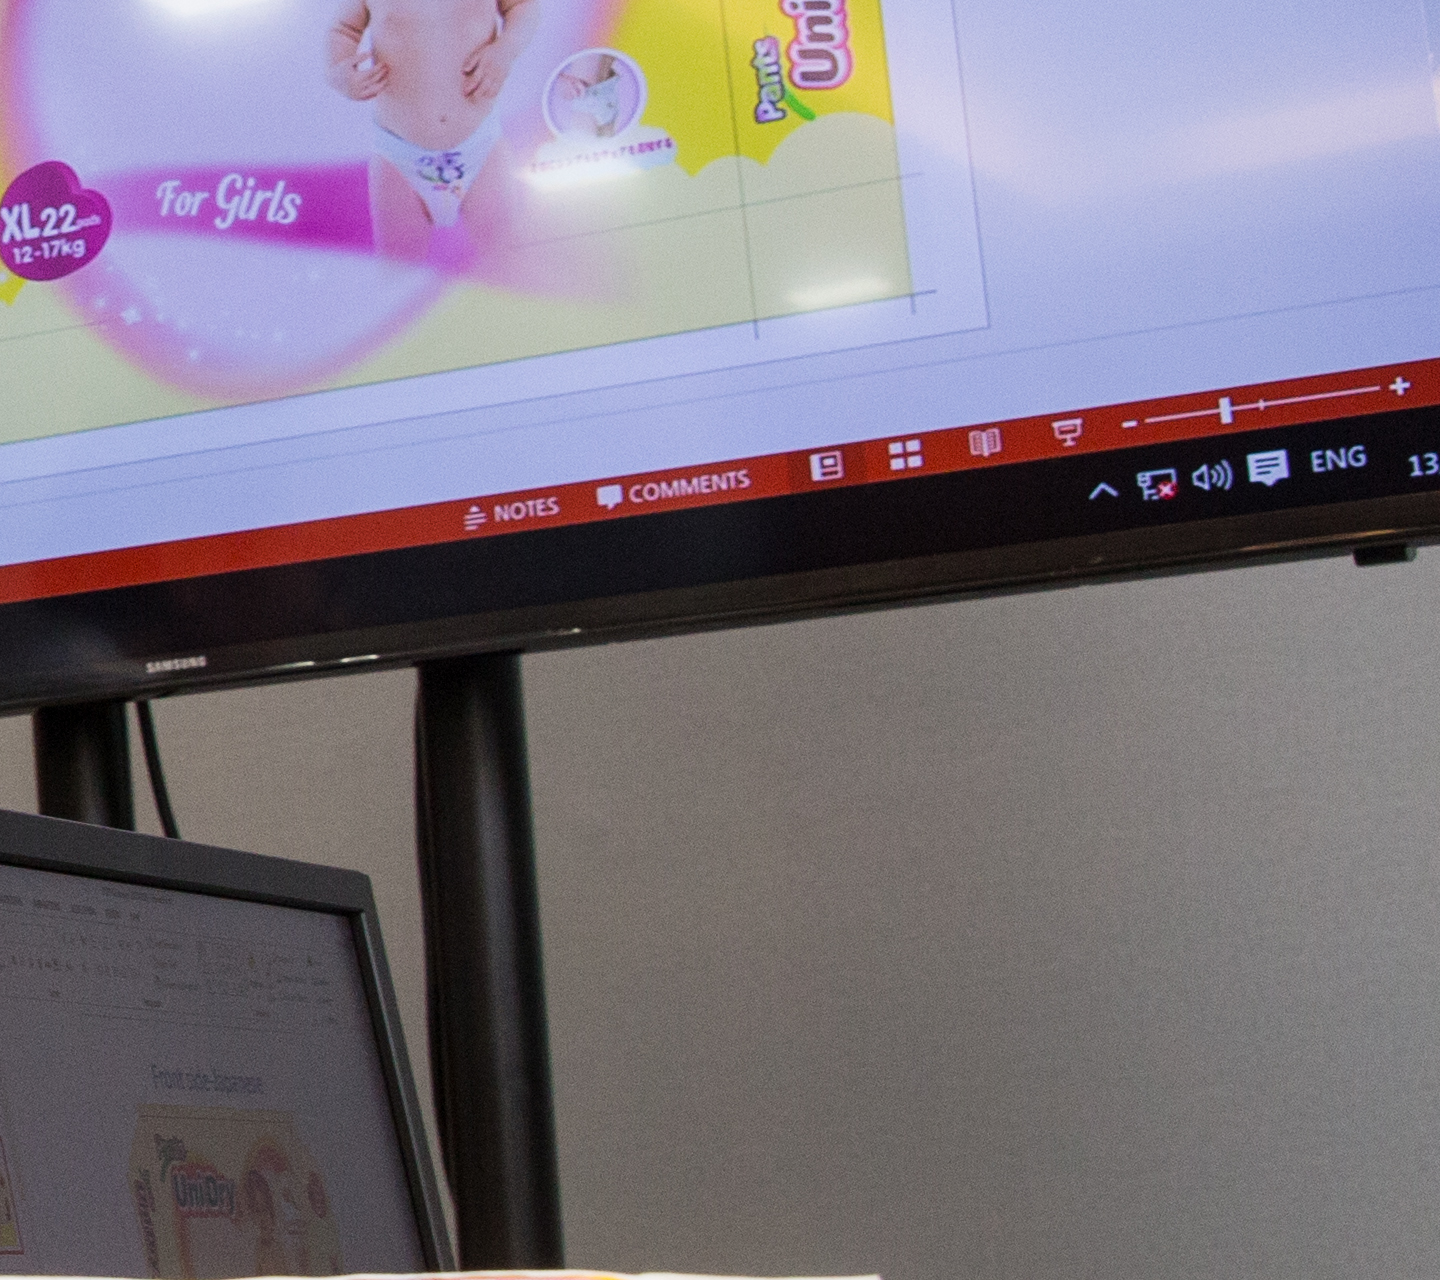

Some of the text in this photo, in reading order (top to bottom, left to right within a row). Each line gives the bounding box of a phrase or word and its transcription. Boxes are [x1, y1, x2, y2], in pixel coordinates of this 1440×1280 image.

[751, 36, 787, 124] Pants
[155, 173, 304, 230] For Girls
[11, 237, 87, 265] 12-17kg
[1310, 443, 1369, 473] ENG
[1408, 451, 1440, 478] 13
[493, 467, 752, 523] NOTES COMMENTS
